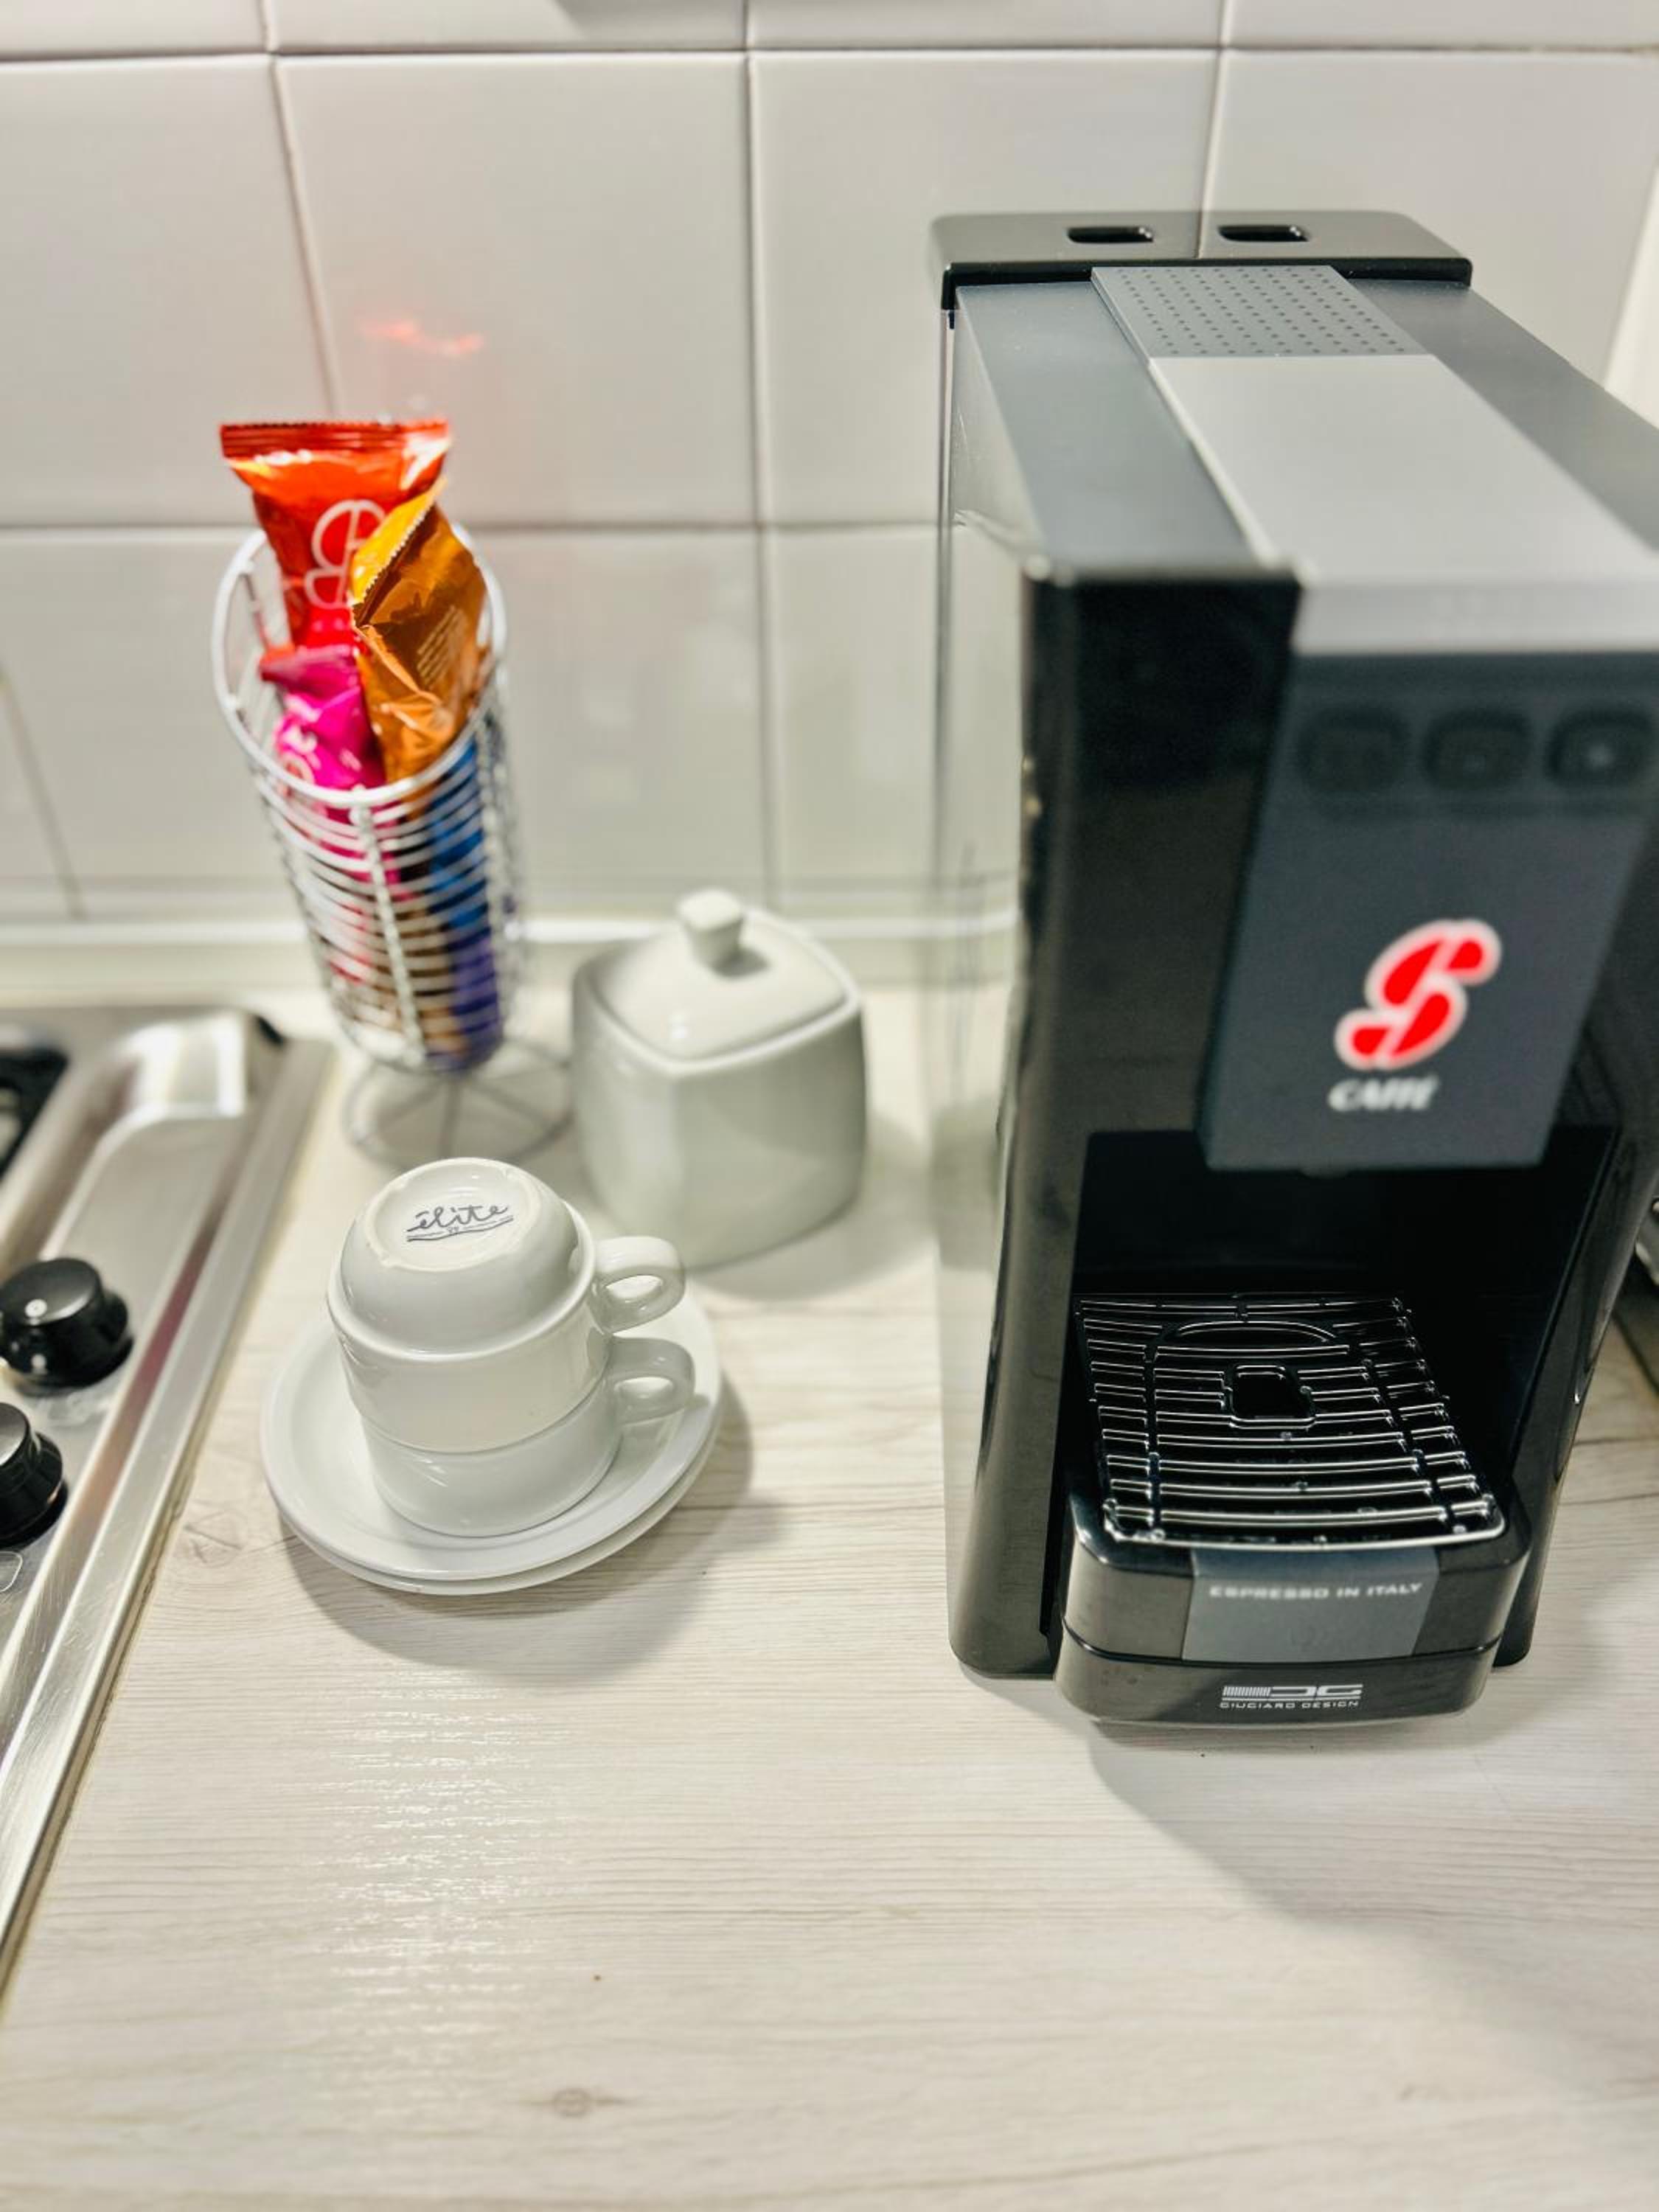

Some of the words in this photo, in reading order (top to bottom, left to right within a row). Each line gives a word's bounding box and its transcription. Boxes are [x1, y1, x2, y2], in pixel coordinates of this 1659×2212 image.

[1209, 1586, 1329, 1600] ESPRESSO
[1336, 1586, 1360, 1599] IN
[1367, 1582, 1422, 1596] ITALY
[1301, 1700, 1359, 1709] DESIGN
